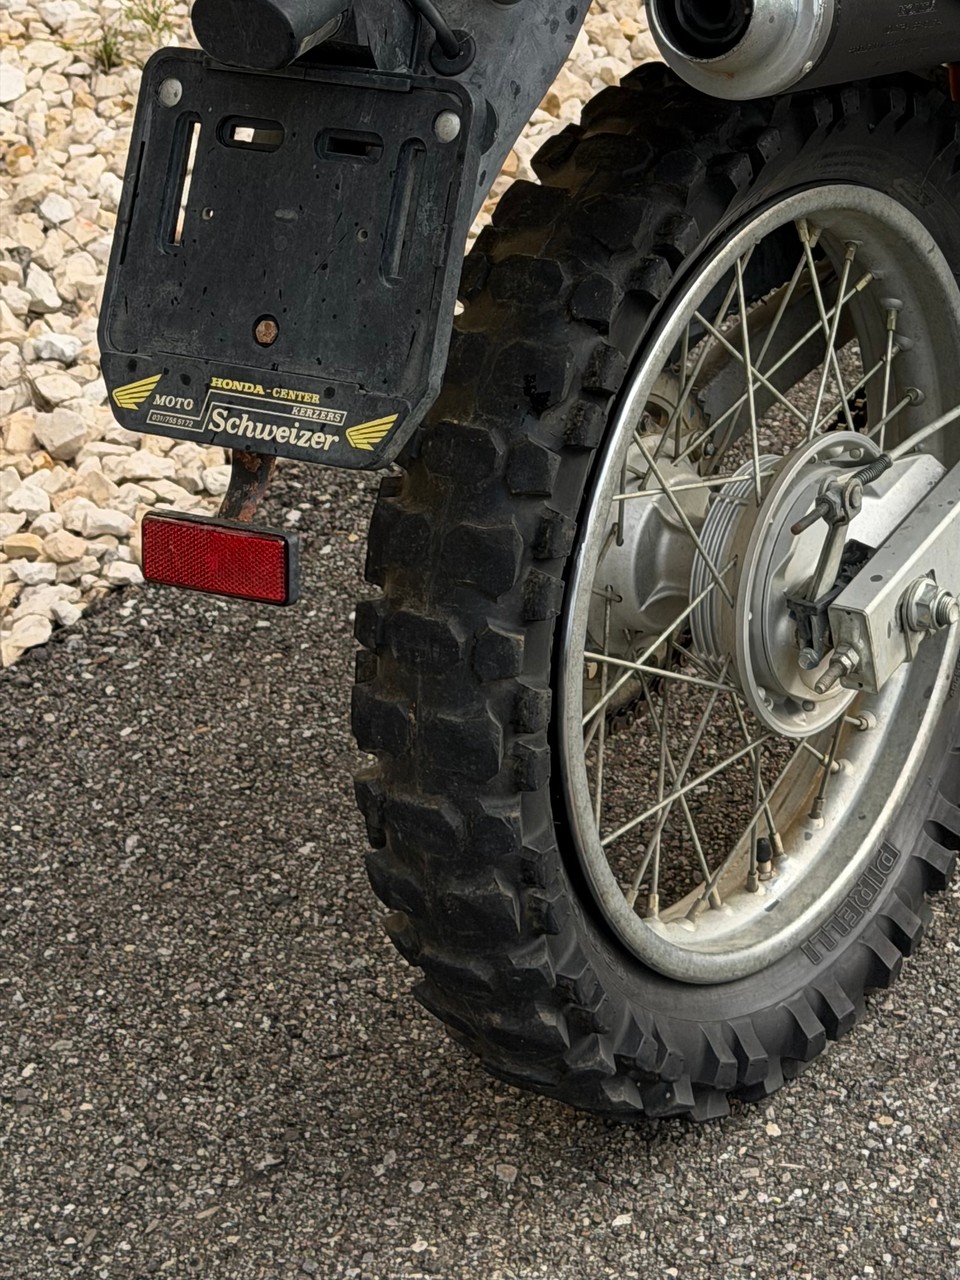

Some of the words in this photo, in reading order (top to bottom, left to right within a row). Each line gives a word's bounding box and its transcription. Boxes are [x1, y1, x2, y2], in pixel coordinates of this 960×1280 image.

[153, 394, 194, 410] MOTO
[291, 406, 342, 422] KERZERS
[208, 408, 340, 451] Schweizer
[800, 840, 901, 966] PIRELLI
